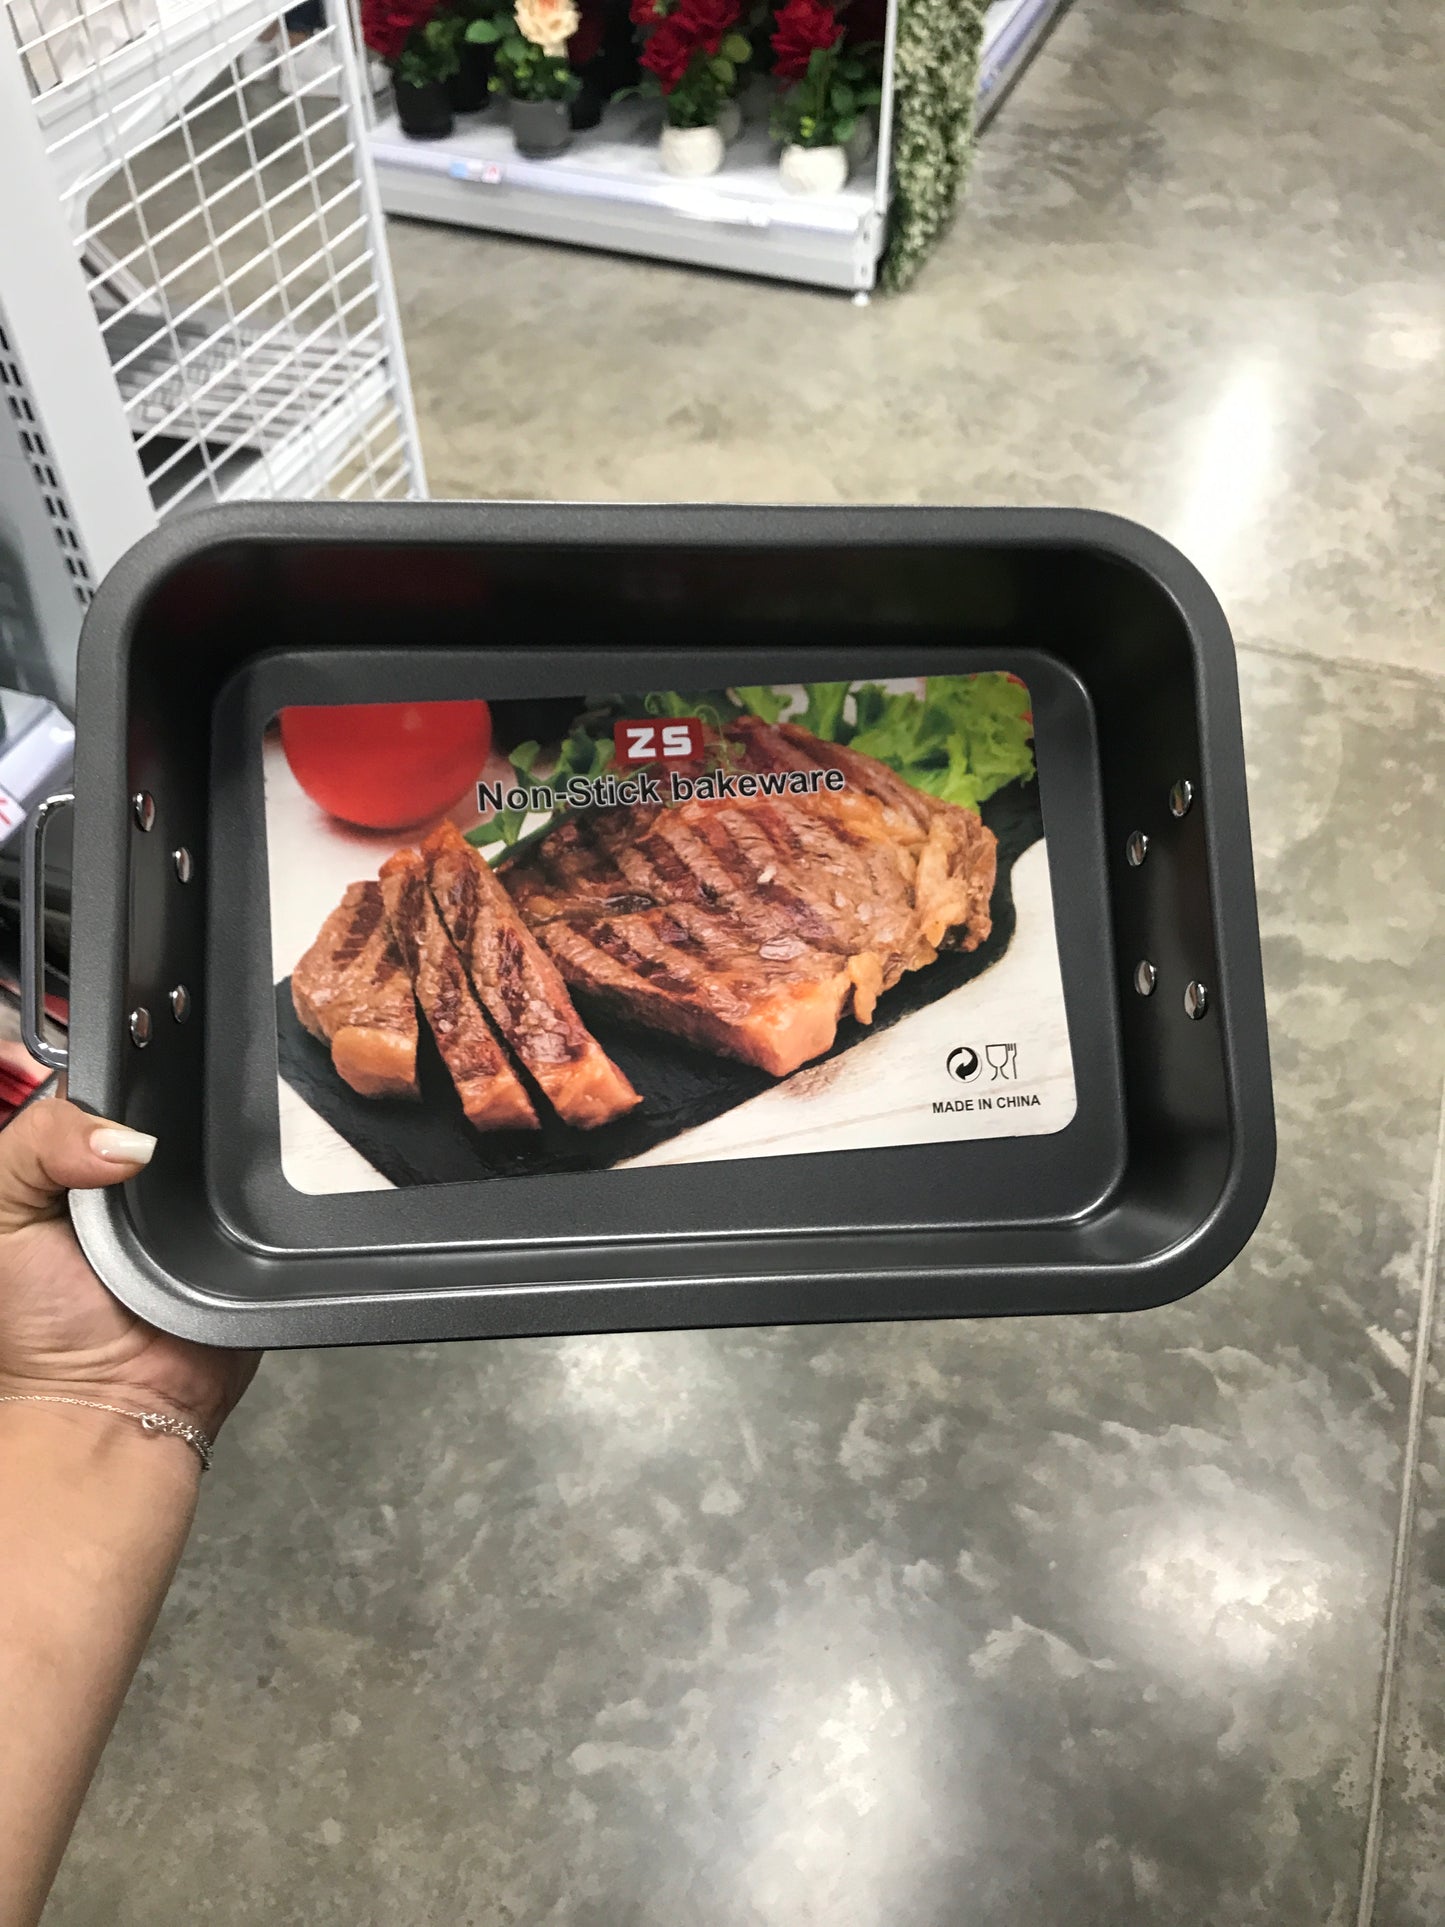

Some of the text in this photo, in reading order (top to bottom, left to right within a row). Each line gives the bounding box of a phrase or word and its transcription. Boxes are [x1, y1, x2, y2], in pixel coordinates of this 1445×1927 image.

[626, 726, 693, 758] ZS
[477, 768, 844, 811] Non-Stick bakeware
[932, 1094, 1041, 1114] MADE IN CHINA
